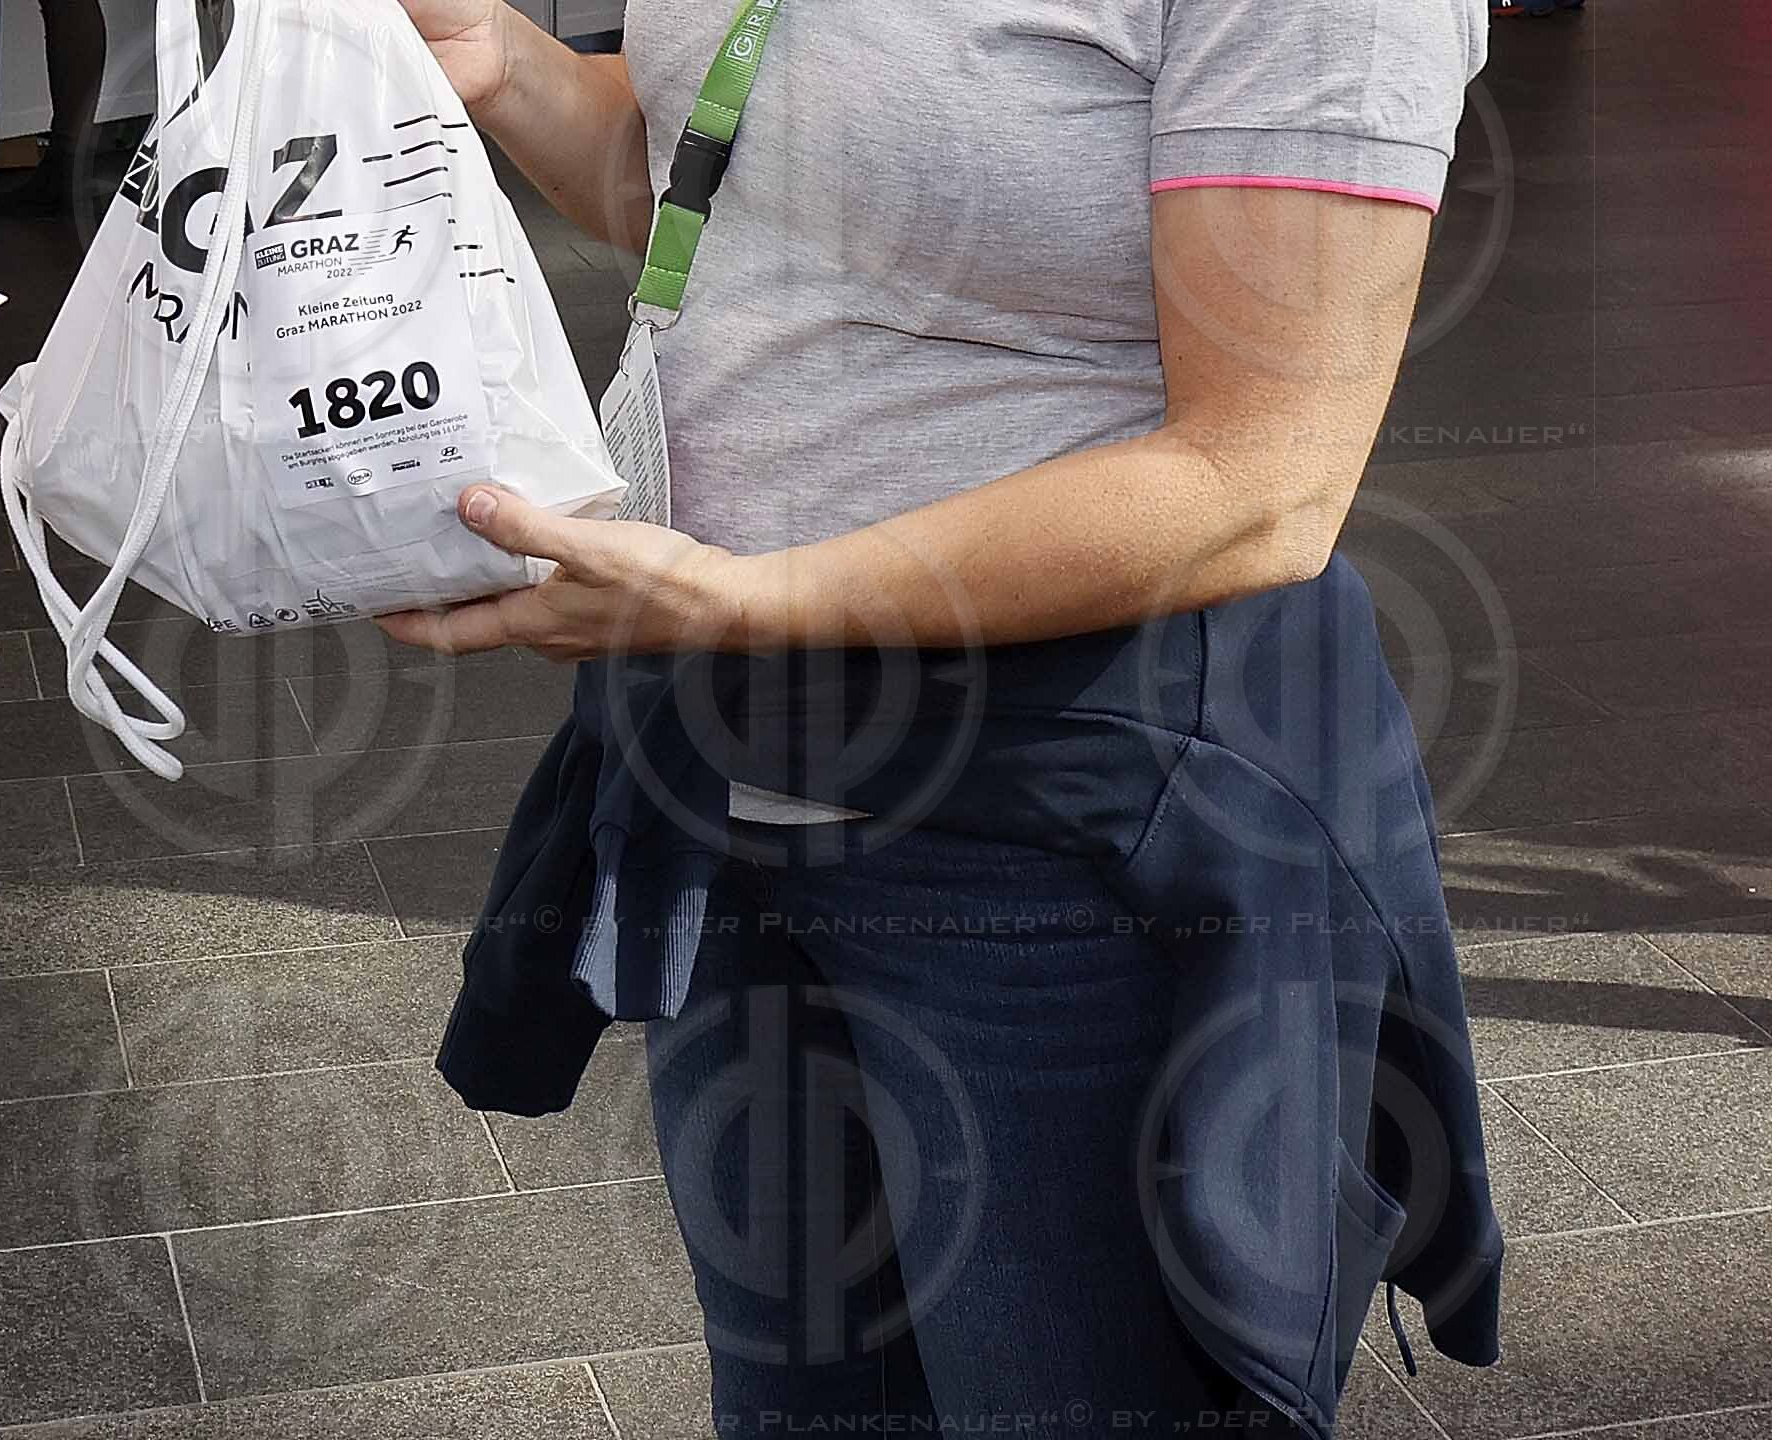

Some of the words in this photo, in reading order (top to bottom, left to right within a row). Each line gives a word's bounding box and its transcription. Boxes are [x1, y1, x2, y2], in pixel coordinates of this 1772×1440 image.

[255, 245, 284, 260] KLEINE
[291, 233, 360, 259] GRAZ
[277, 257, 343, 277] MARATHON
[327, 267, 353, 279] 2022
[298, 298, 340, 317] Kleine
[343, 293, 394, 309] Zeitung
[276, 324, 306, 339] Graz
[308, 309, 388, 332] MARATHON
[392, 300, 423, 317] 2022
[288, 361, 440, 439] 1820
[375, 428, 405, 440] Sonntag
